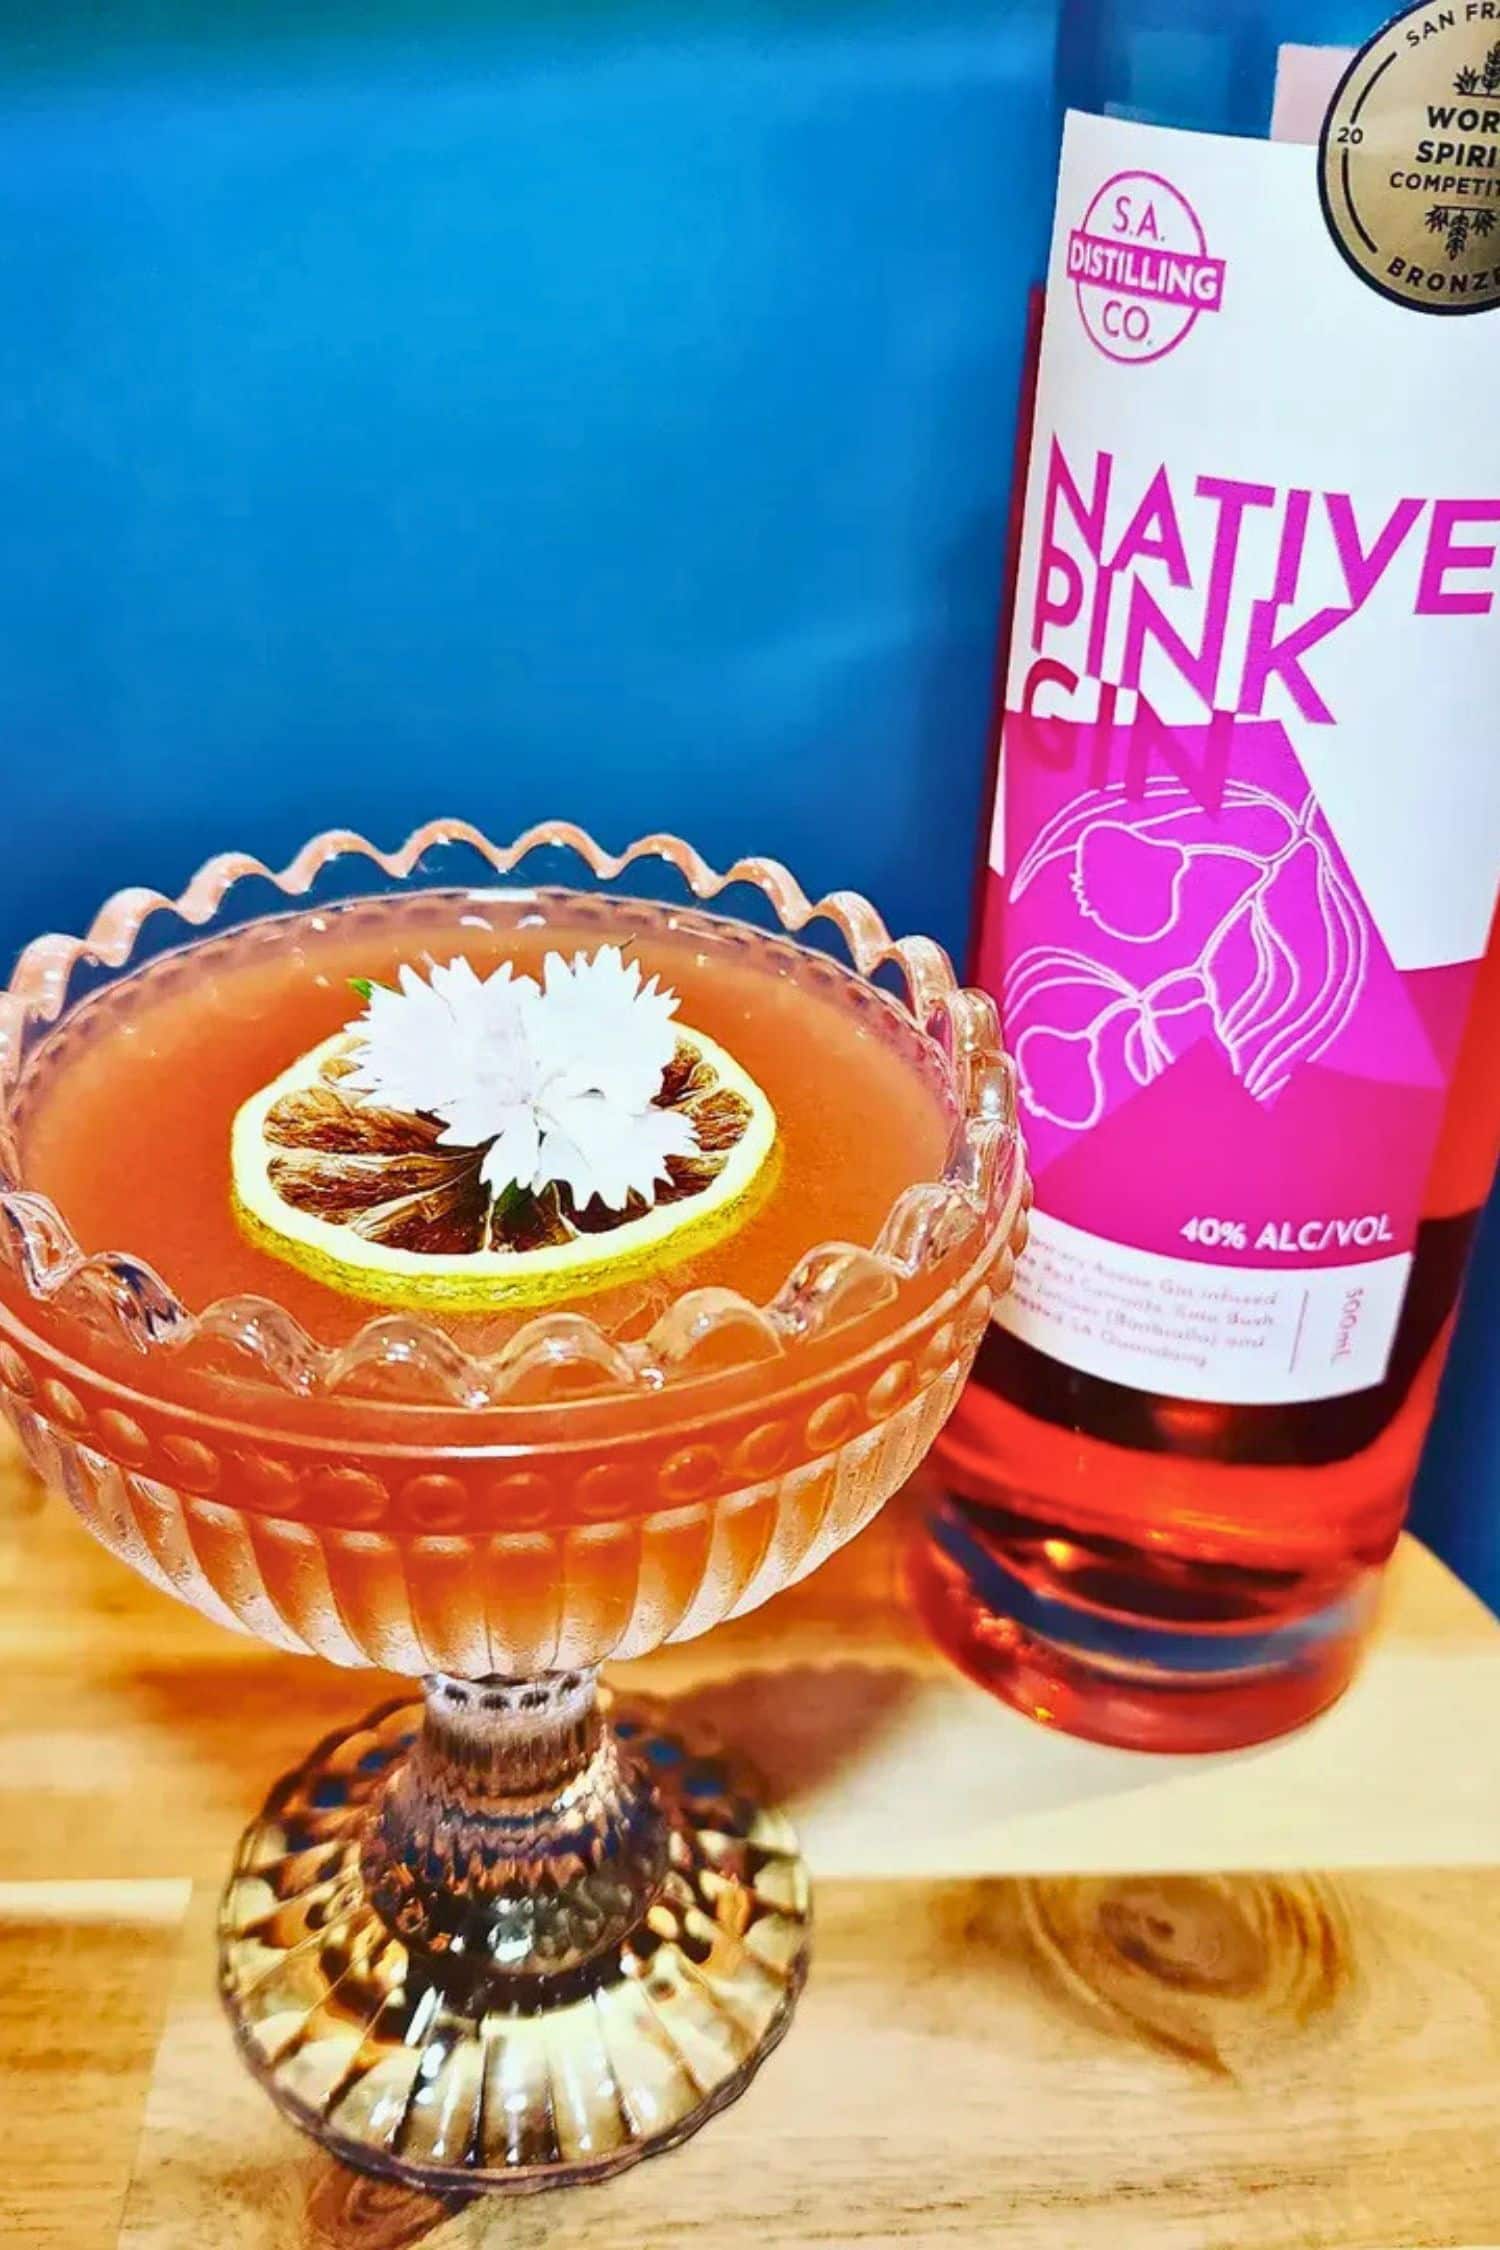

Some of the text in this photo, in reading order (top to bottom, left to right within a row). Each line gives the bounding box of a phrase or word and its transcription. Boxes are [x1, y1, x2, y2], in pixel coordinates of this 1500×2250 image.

[1406, 1, 1500, 47] SAN FR
[1337, 127, 1363, 145] 20
[1112, 195, 1166, 243] S.A.
[1069, 239, 1219, 299] DISTILLING
[1103, 300, 1153, 345] CO.
[1049, 430, 1500, 615] NATIVE
[1031, 544, 1358, 726] PINK
[1021, 656, 1237, 822] GIN
[1179, 1213, 1394, 1251] 40% ALC/VOL
